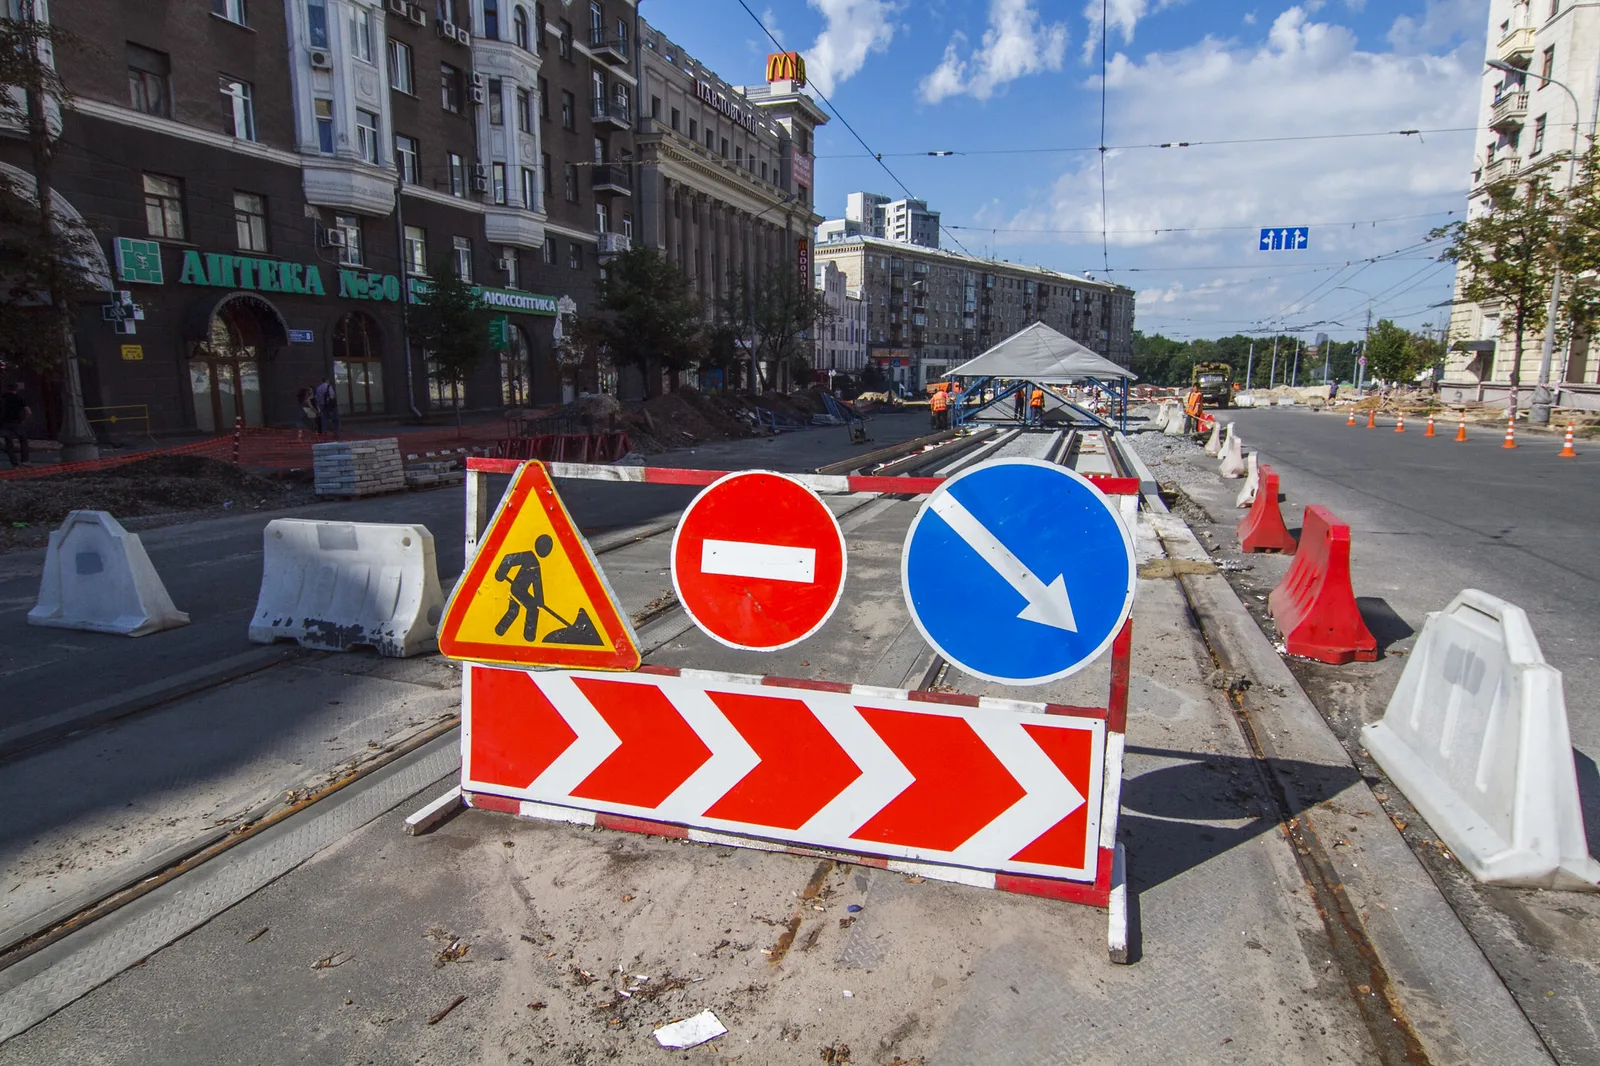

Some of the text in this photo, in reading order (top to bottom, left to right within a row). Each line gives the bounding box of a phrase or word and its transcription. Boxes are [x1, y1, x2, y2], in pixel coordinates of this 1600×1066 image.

[696, 79, 759, 135] ПАВЛОВСКИЙ
[179, 249, 400, 302] АПТЕКА №50
[483, 290, 556, 312] ЛЮКСОПТИКА
